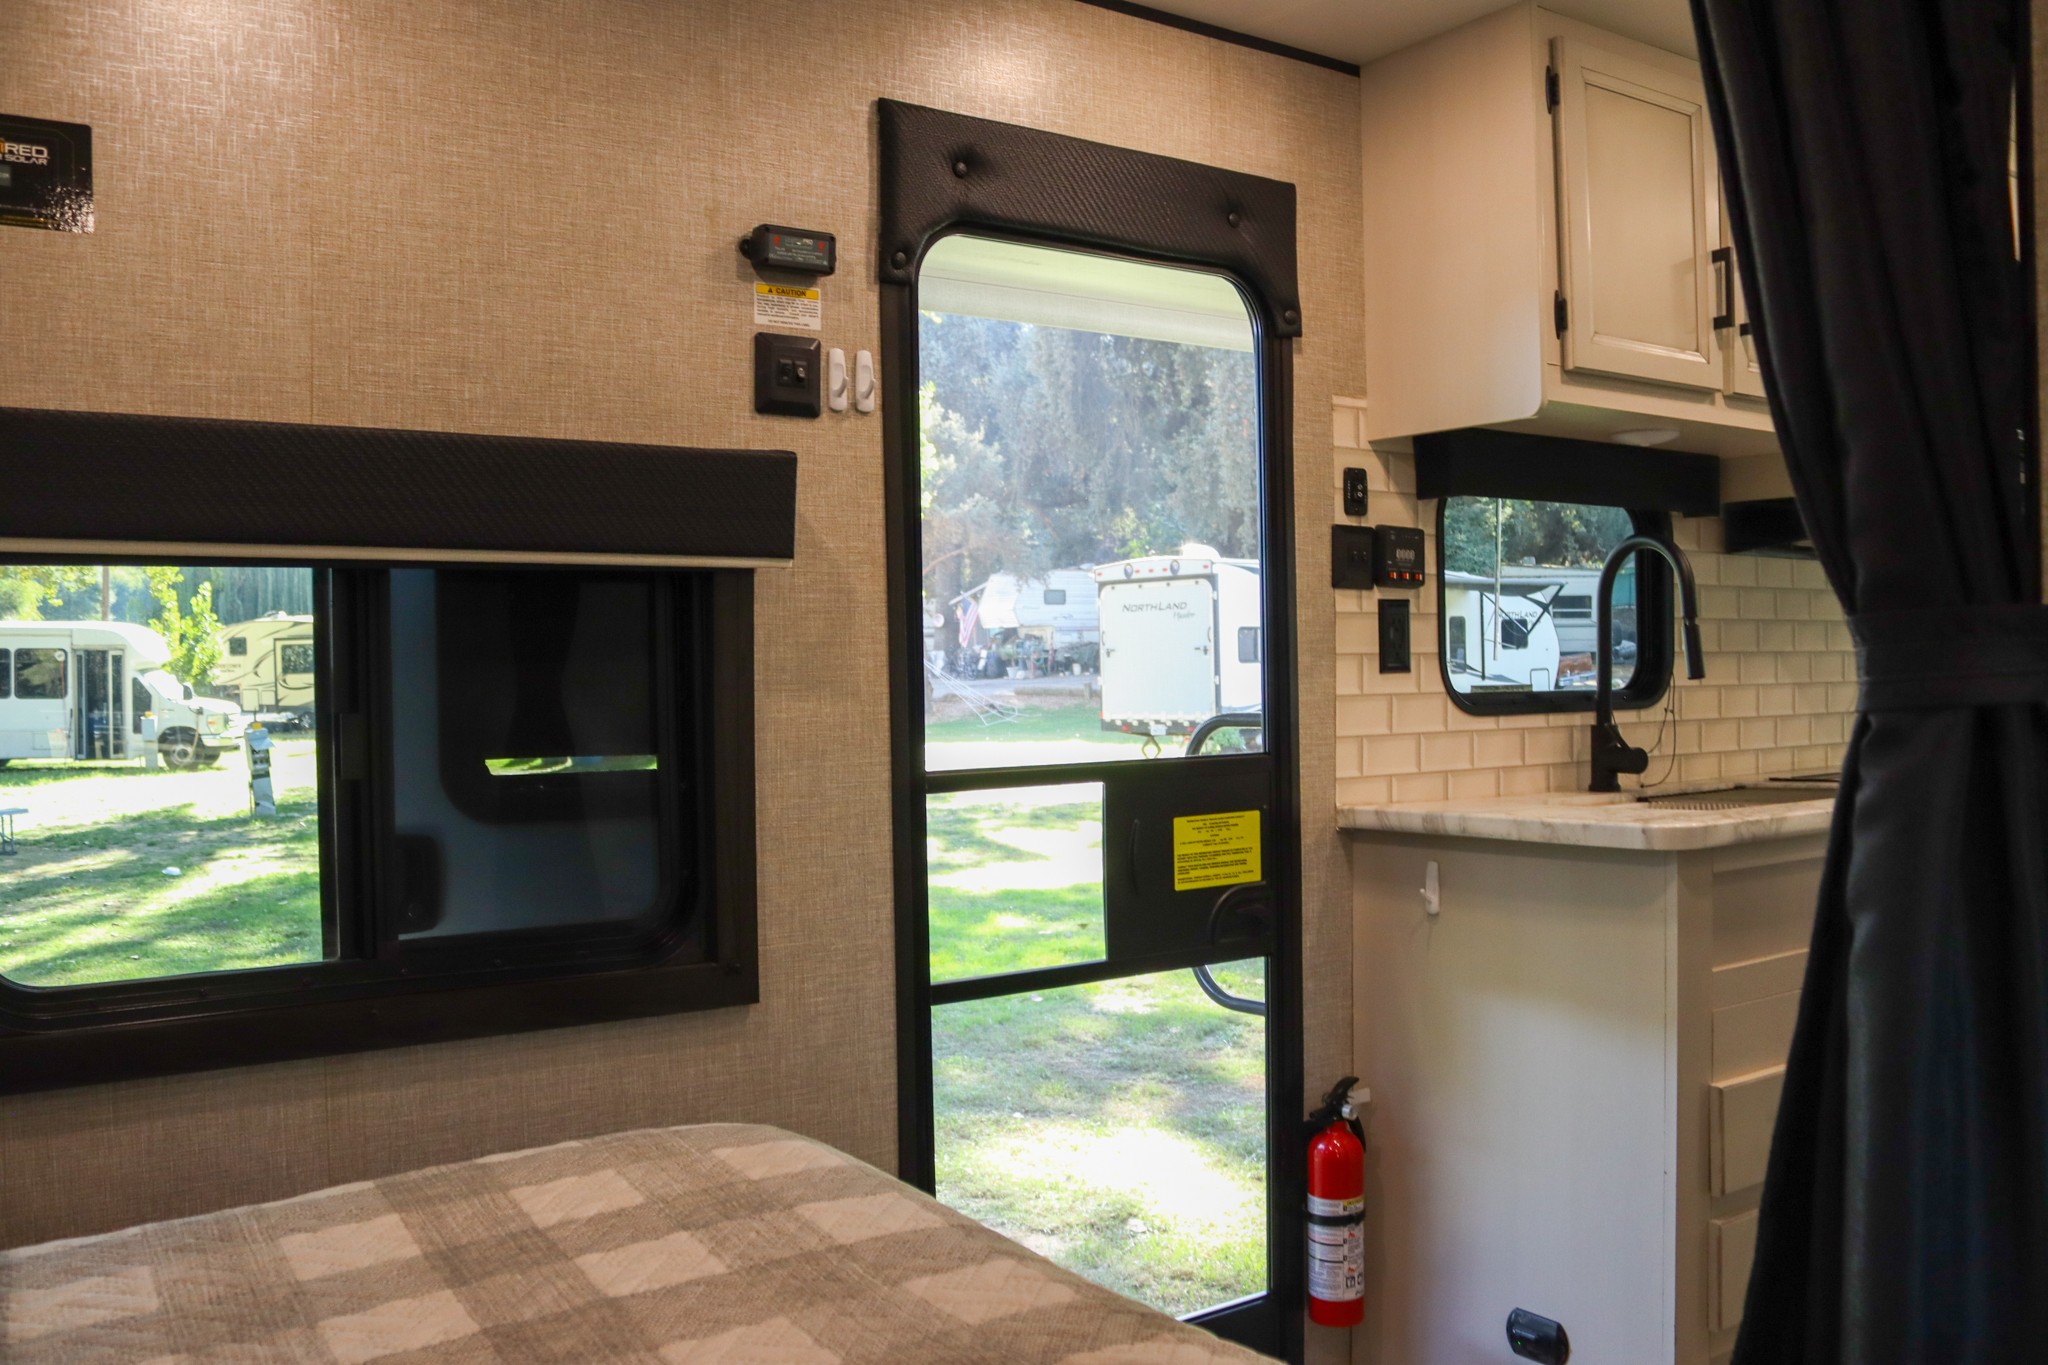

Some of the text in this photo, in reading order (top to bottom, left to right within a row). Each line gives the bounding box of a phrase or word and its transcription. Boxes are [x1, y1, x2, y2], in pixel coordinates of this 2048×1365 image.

[5, 153, 47, 166] SOLAR
[775, 287, 807, 297] CAUTION
[1122, 601, 1188, 613] NORTHLAND
